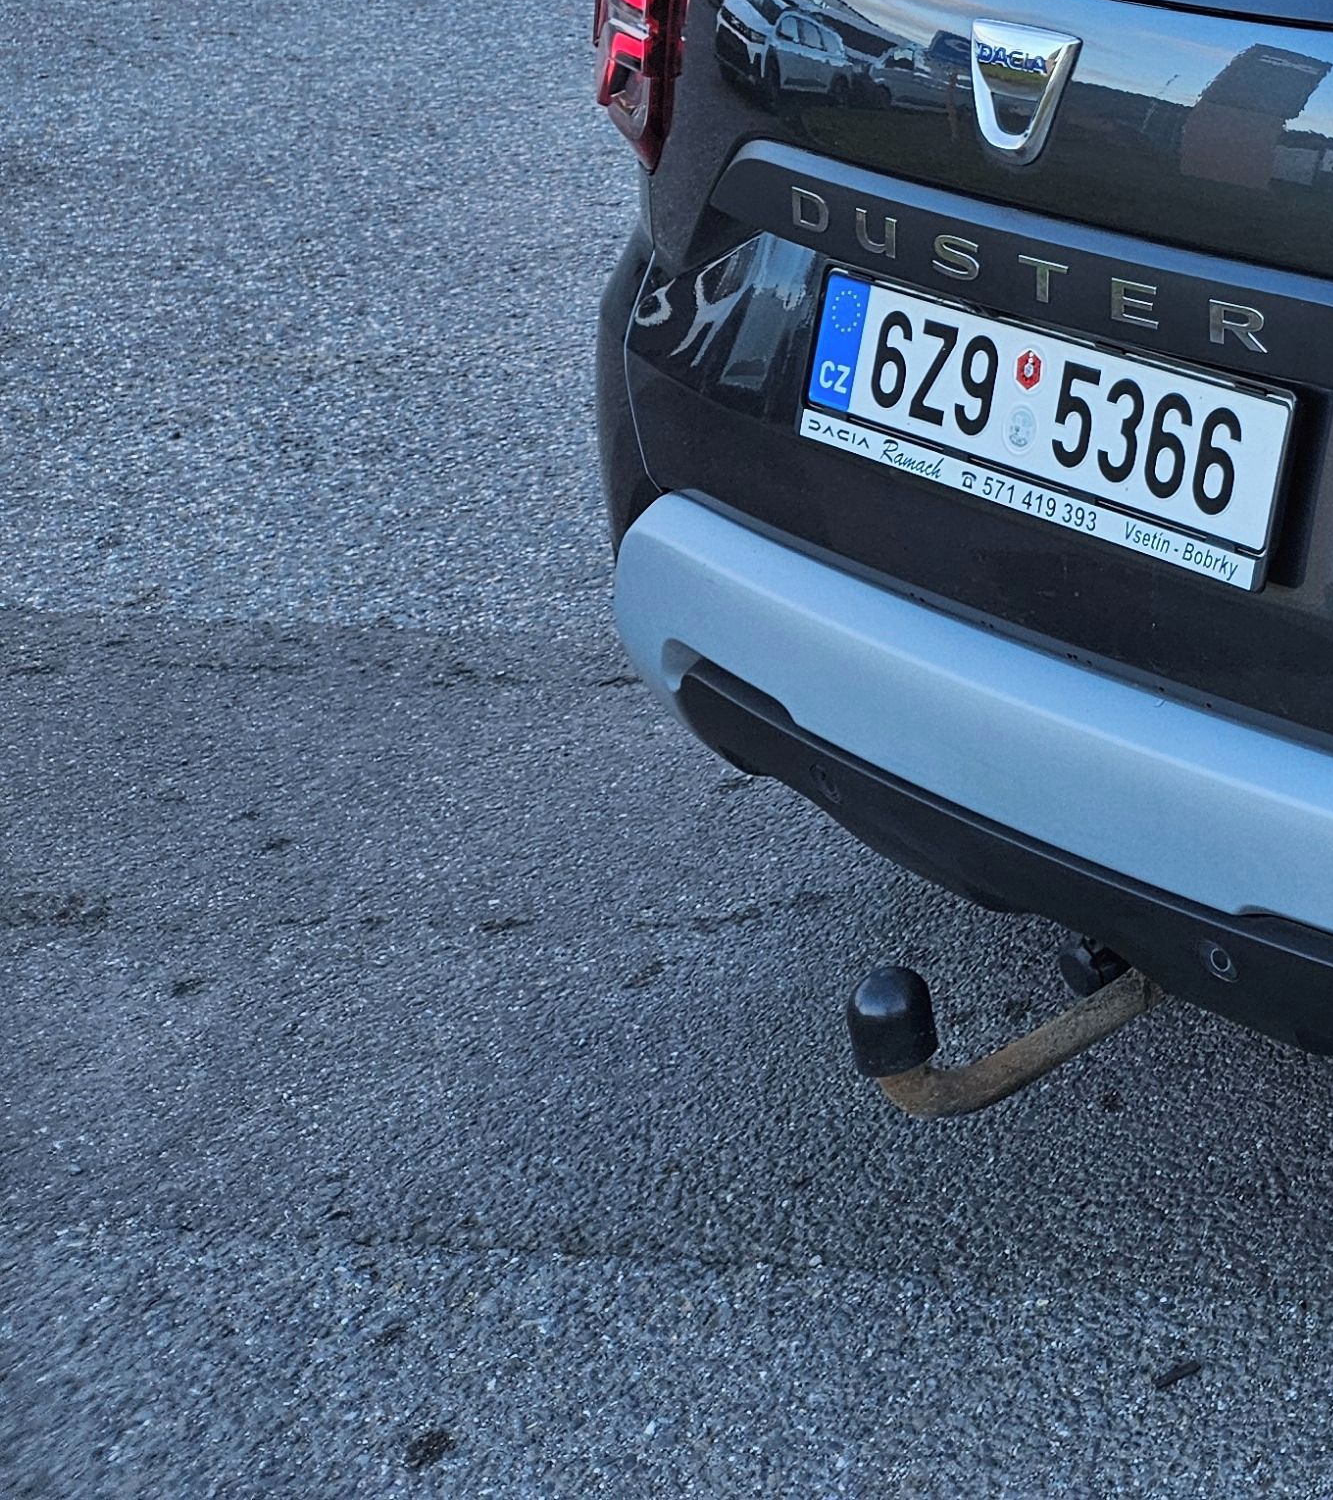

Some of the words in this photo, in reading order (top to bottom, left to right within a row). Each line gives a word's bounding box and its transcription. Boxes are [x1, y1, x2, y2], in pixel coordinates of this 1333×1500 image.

[976, 44, 1048, 77] DACIA
[791, 186, 1268, 354] DUSTER
[818, 360, 851, 395] CZ
[870, 310, 1000, 436] 6Z9
[1051, 360, 1243, 516] 5366
[808, 419, 870, 449] DACIA
[879, 438, 945, 480] Ramach
[982, 475, 1016, 504] 571
[1021, 490, 1058, 518] 419
[1062, 502, 1098, 532] 393
[1182, 542, 1239, 580] Bobrky
